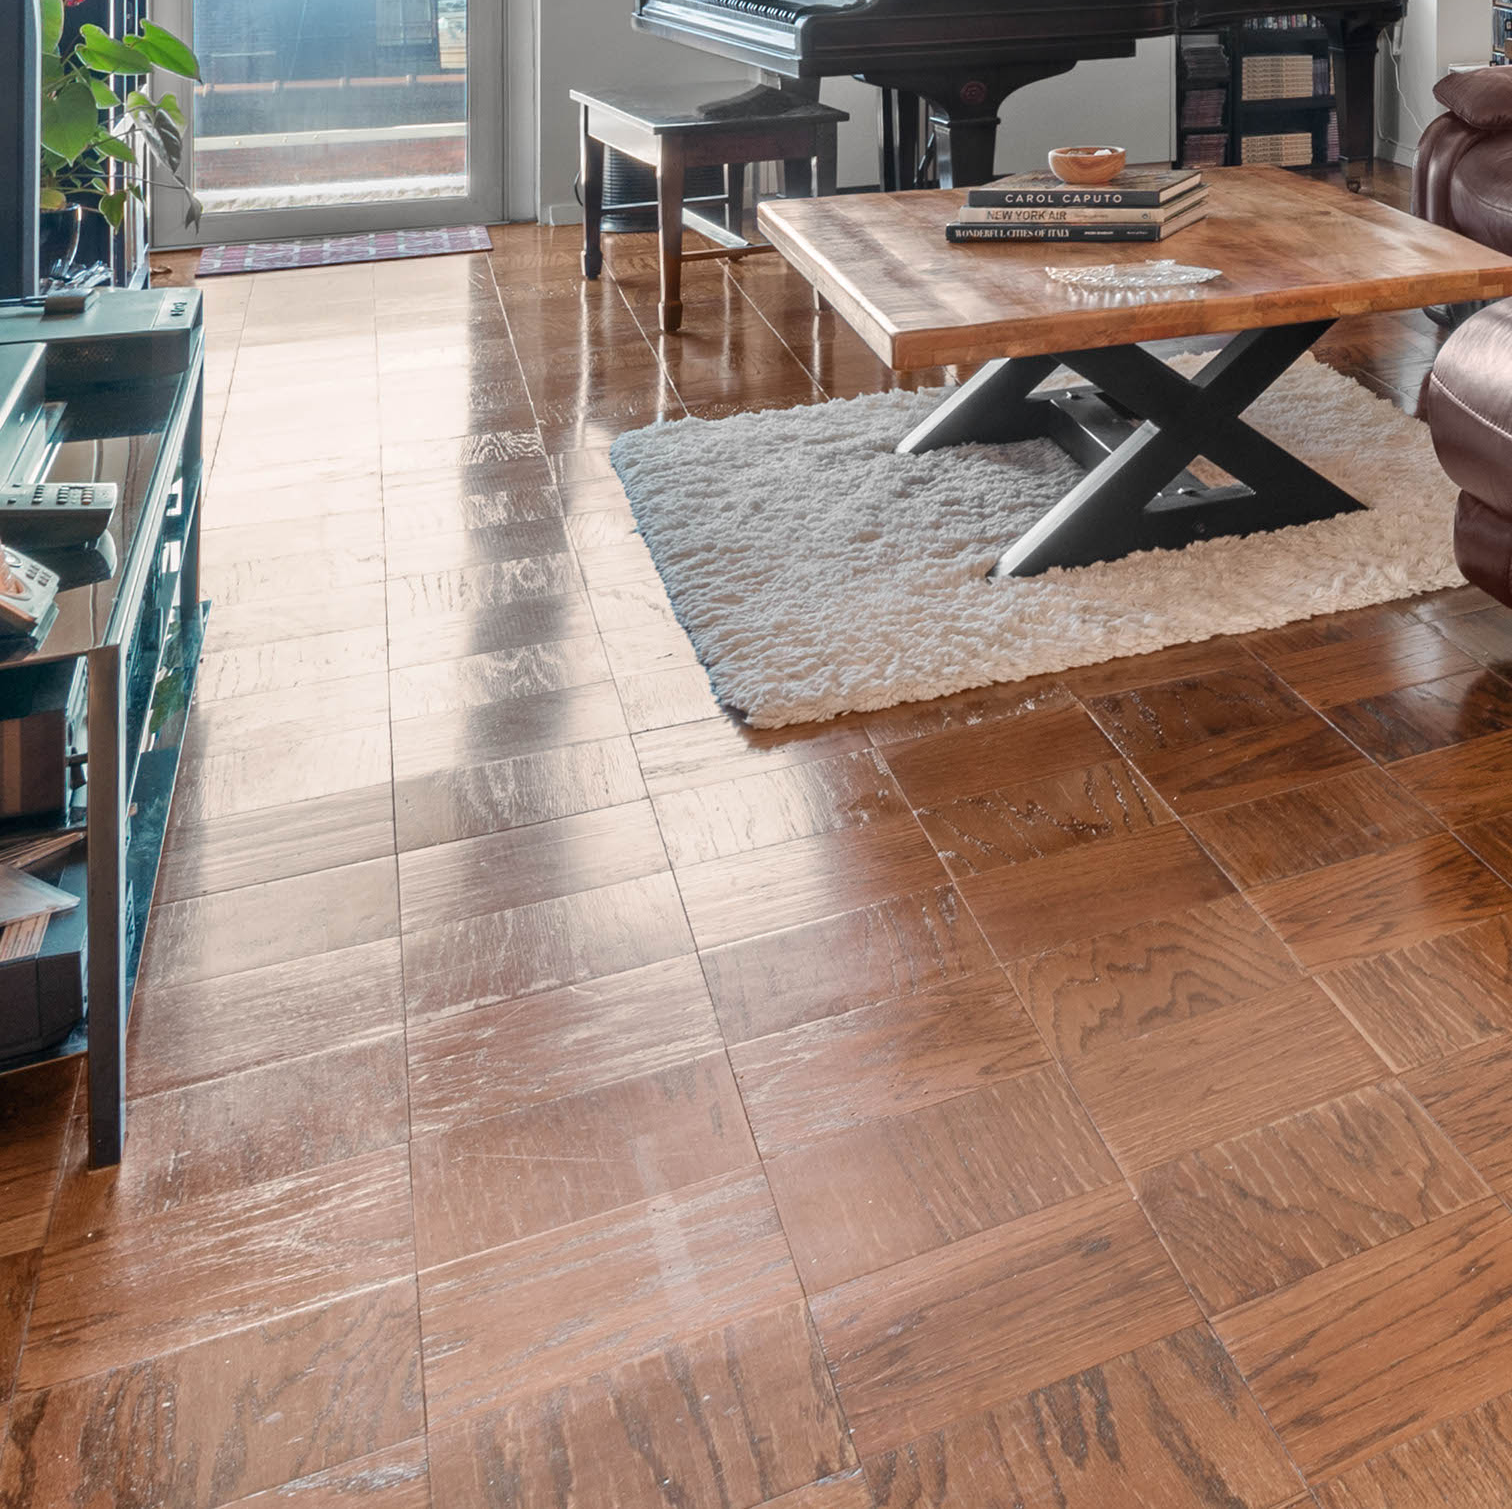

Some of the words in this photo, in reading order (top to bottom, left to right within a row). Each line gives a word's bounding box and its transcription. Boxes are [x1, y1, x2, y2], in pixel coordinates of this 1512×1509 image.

[1005, 194, 1054, 203] CAROL
[1062, 194, 1122, 203] CAPUTO
[987, 210, 1013, 220] NEW
[1015, 210, 1046, 220] YORK
[1048, 210, 1067, 220] AIR
[955, 229, 1006, 238] WONDERFUL
[1007, 229, 1034, 238] CITIES
[1034, 229, 1046, 238] OF
[1047, 229, 1070, 238] ITALY
